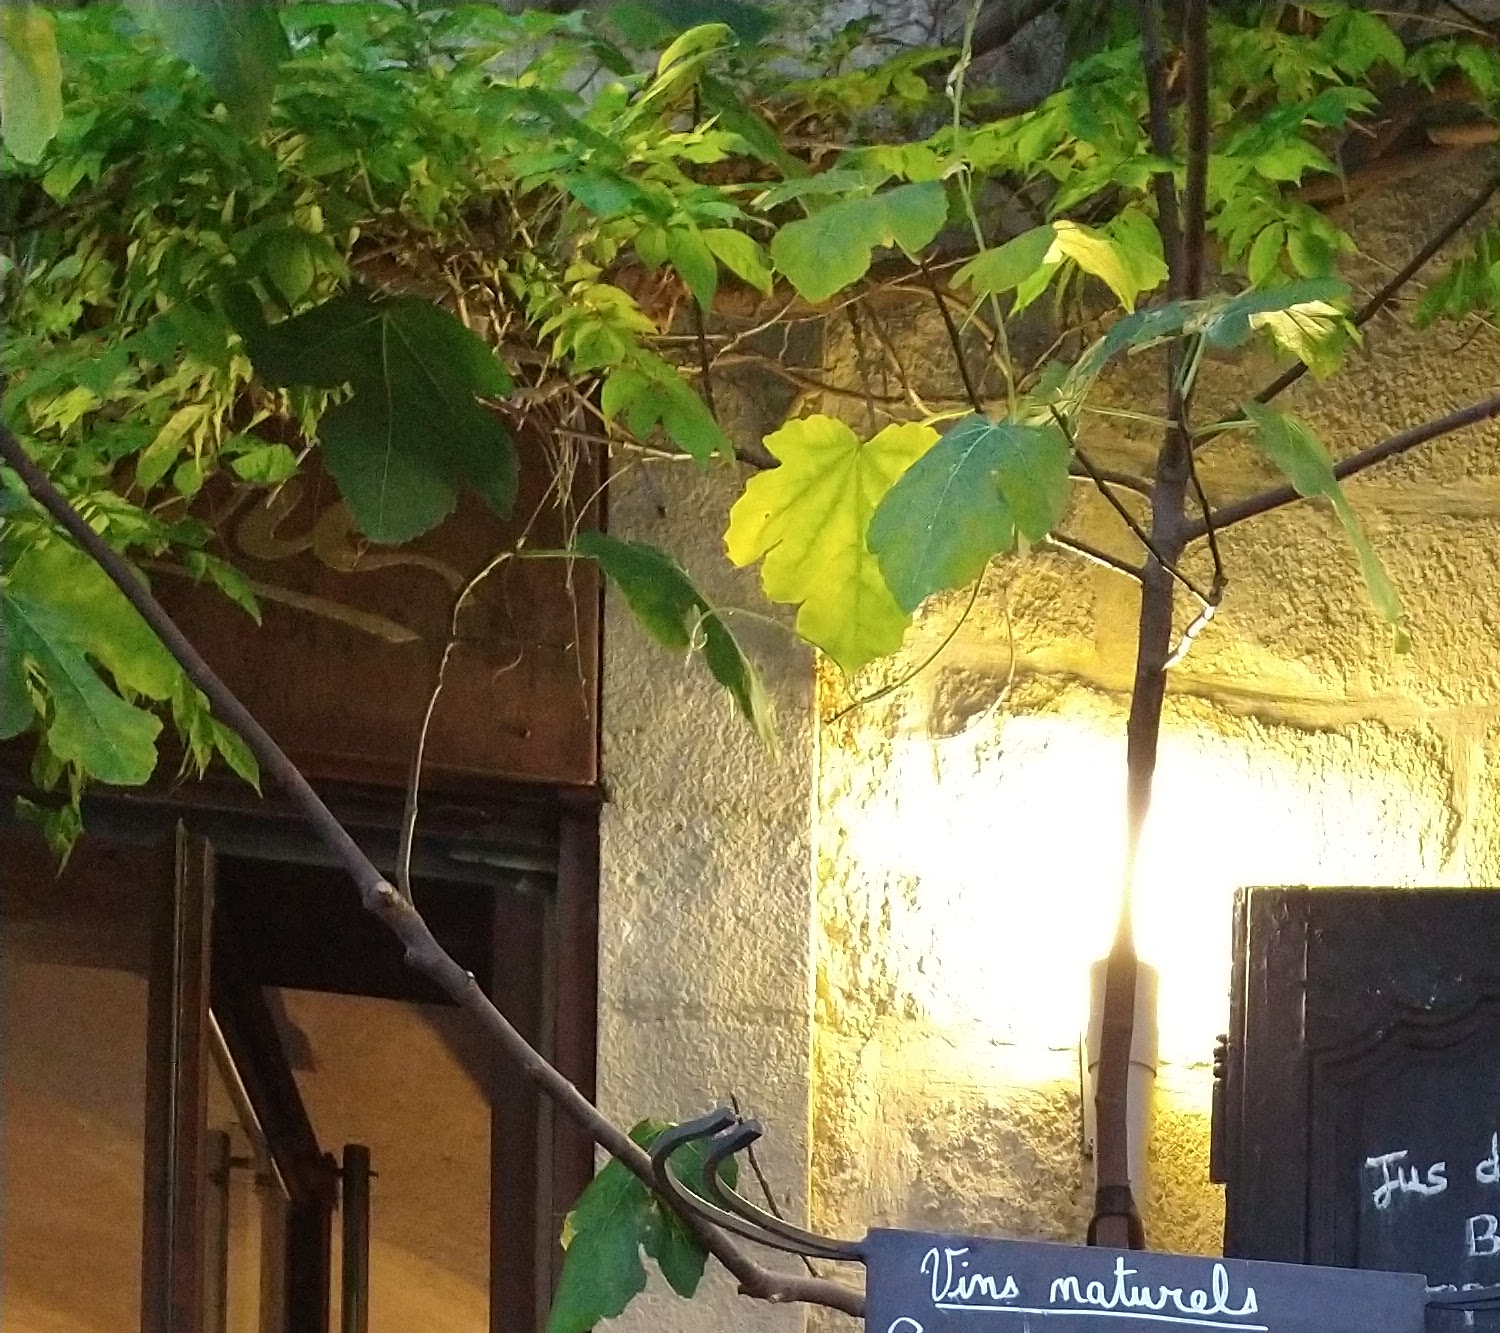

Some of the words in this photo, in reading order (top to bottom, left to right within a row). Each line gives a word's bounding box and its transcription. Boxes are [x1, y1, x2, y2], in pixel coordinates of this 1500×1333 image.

[1365, 1149, 1448, 1209] Jus
[920, 1247, 1020, 1301] Vins
[1049, 1257, 1258, 1315] naturels
